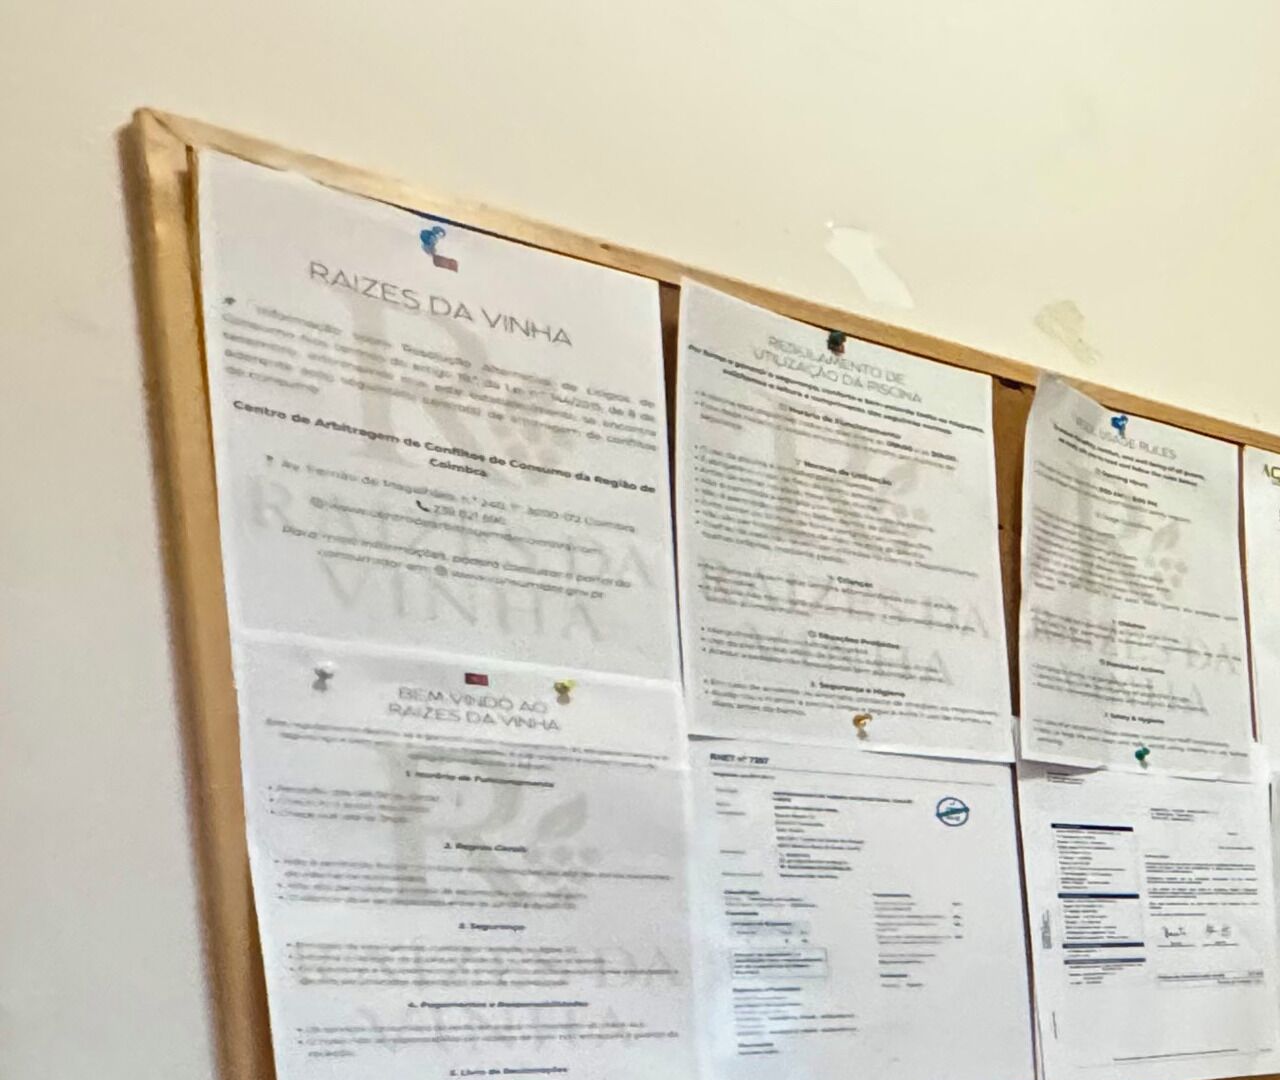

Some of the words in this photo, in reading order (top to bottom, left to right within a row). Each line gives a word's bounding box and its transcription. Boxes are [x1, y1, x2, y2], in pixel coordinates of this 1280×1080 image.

[309, 261, 420, 310] RAIZES
[429, 295, 474, 322] DA
[481, 308, 573, 347] VINHA
